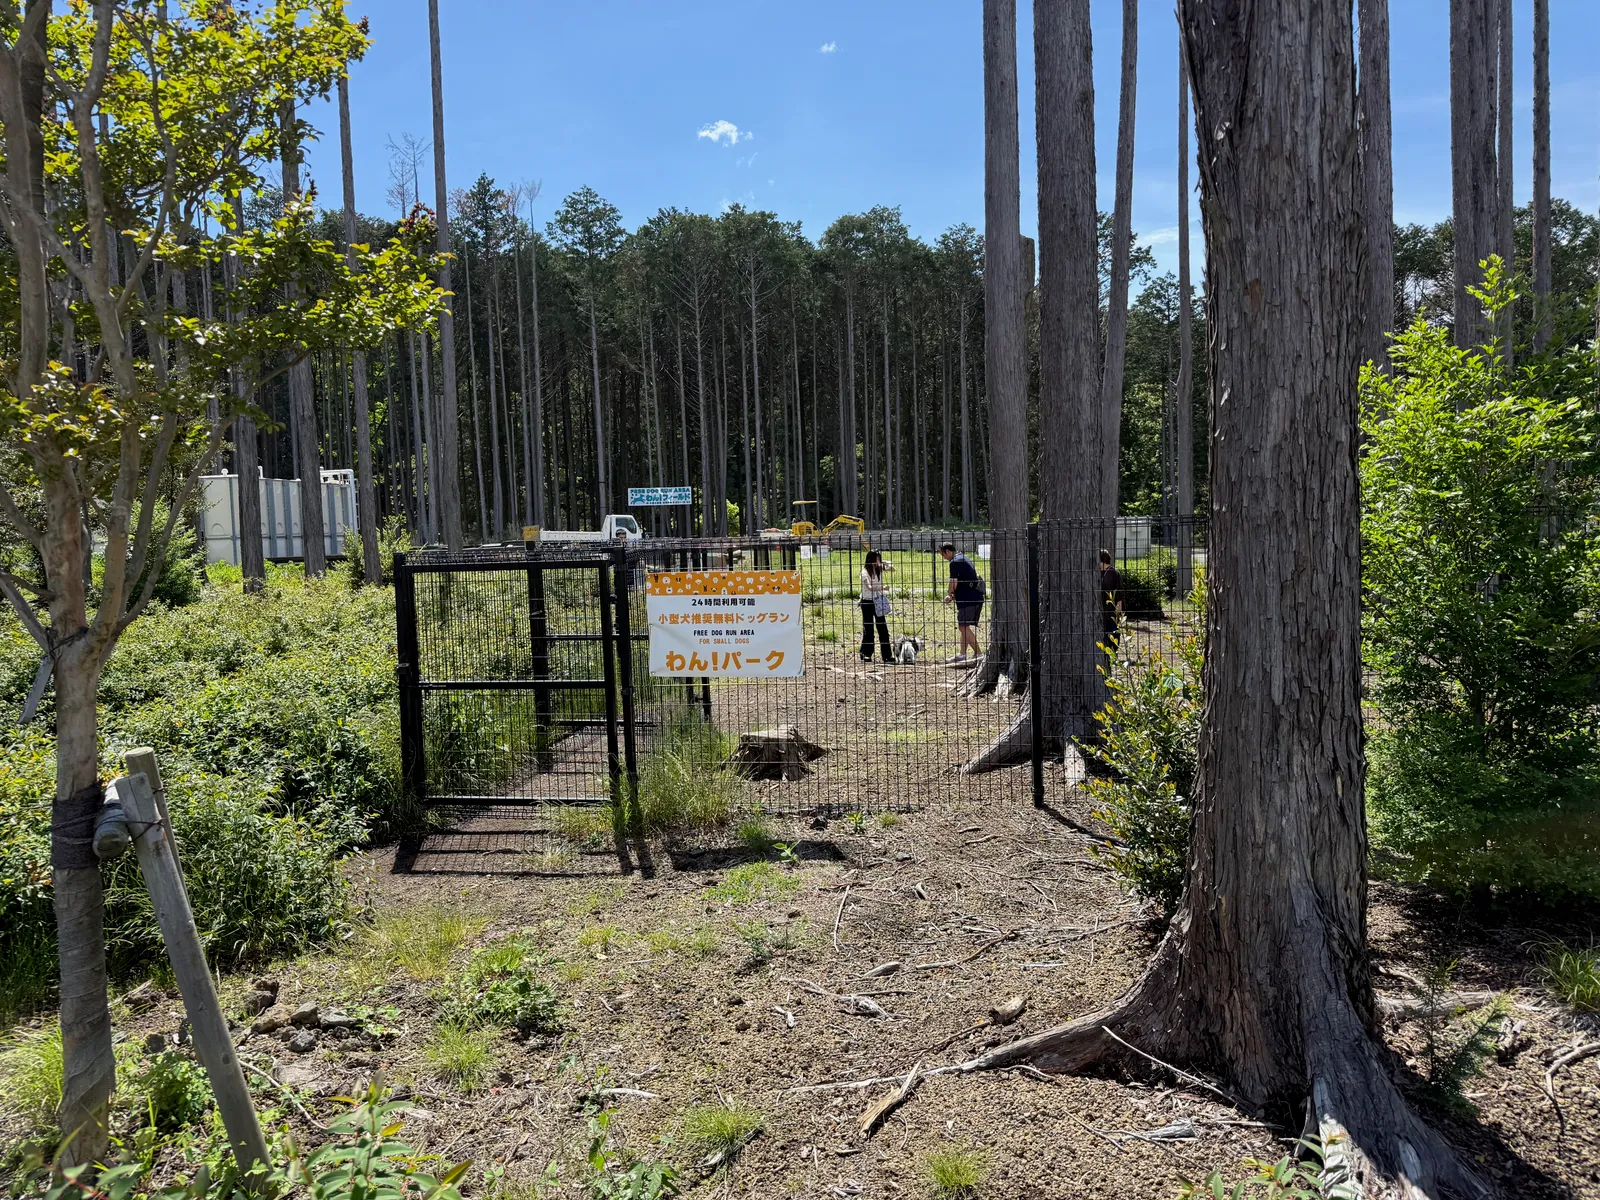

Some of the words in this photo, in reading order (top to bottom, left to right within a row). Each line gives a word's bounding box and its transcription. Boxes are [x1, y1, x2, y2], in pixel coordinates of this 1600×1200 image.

[691, 598, 756, 606] 24時間利用可能
[658, 613, 790, 625] 小型犬推奨無料ドッグラン
[666, 650, 785, 672] わん!パーク
